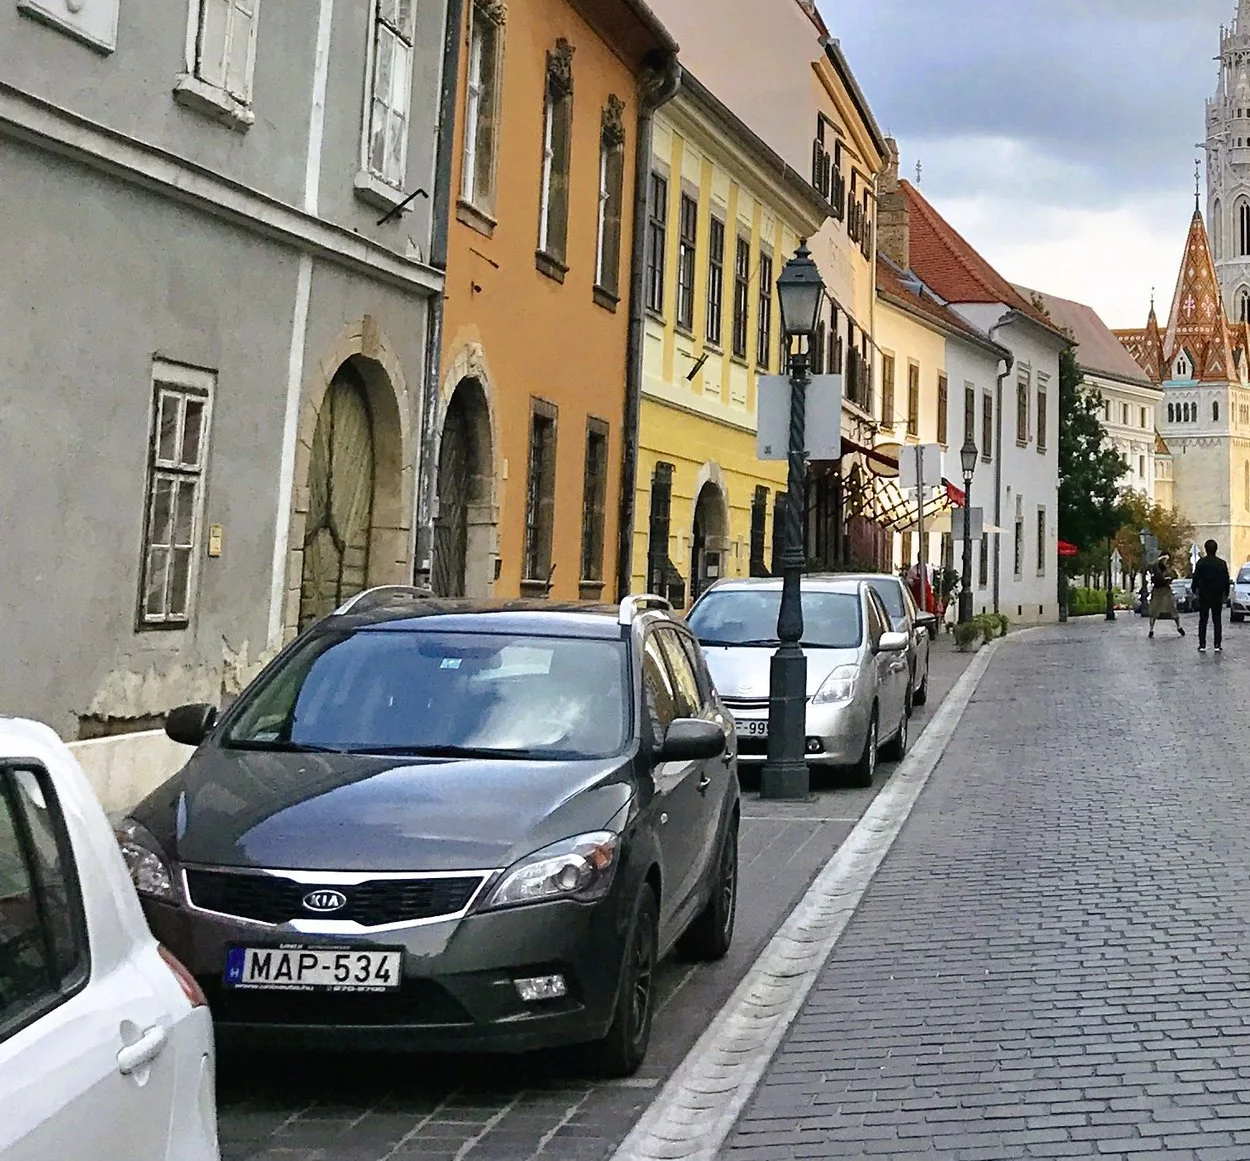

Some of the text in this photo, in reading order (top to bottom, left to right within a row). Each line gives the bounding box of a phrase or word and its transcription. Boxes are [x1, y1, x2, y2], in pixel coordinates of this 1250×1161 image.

[735, 721, 769, 735] F-99
[310, 894, 339, 907] KIA
[249, 951, 391, 983] MAP-534
